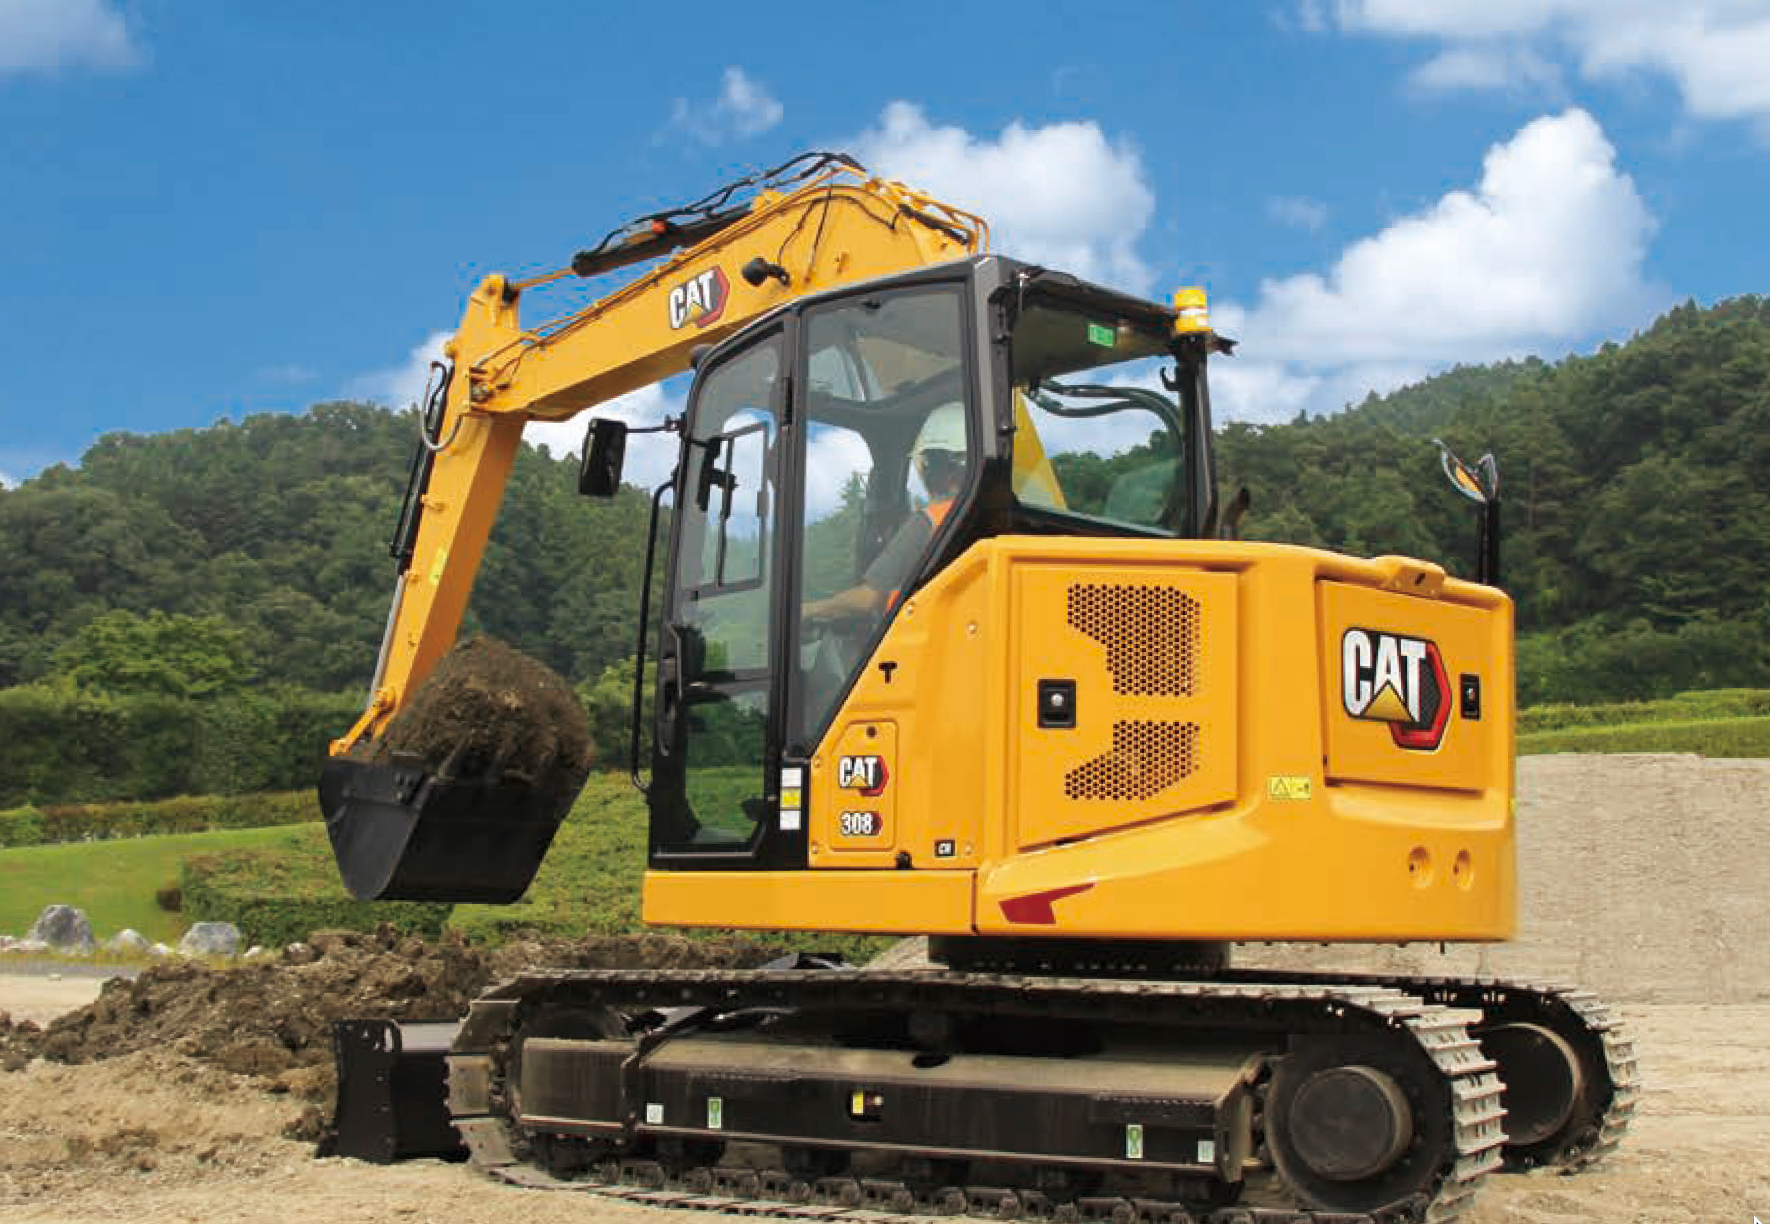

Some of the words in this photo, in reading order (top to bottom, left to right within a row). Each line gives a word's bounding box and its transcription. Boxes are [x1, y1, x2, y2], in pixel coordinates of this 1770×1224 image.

[669, 270, 715, 329] CAT
[1342, 629, 1426, 722] CAT
[840, 756, 878, 788] CAT
[841, 812, 873, 834] 308
